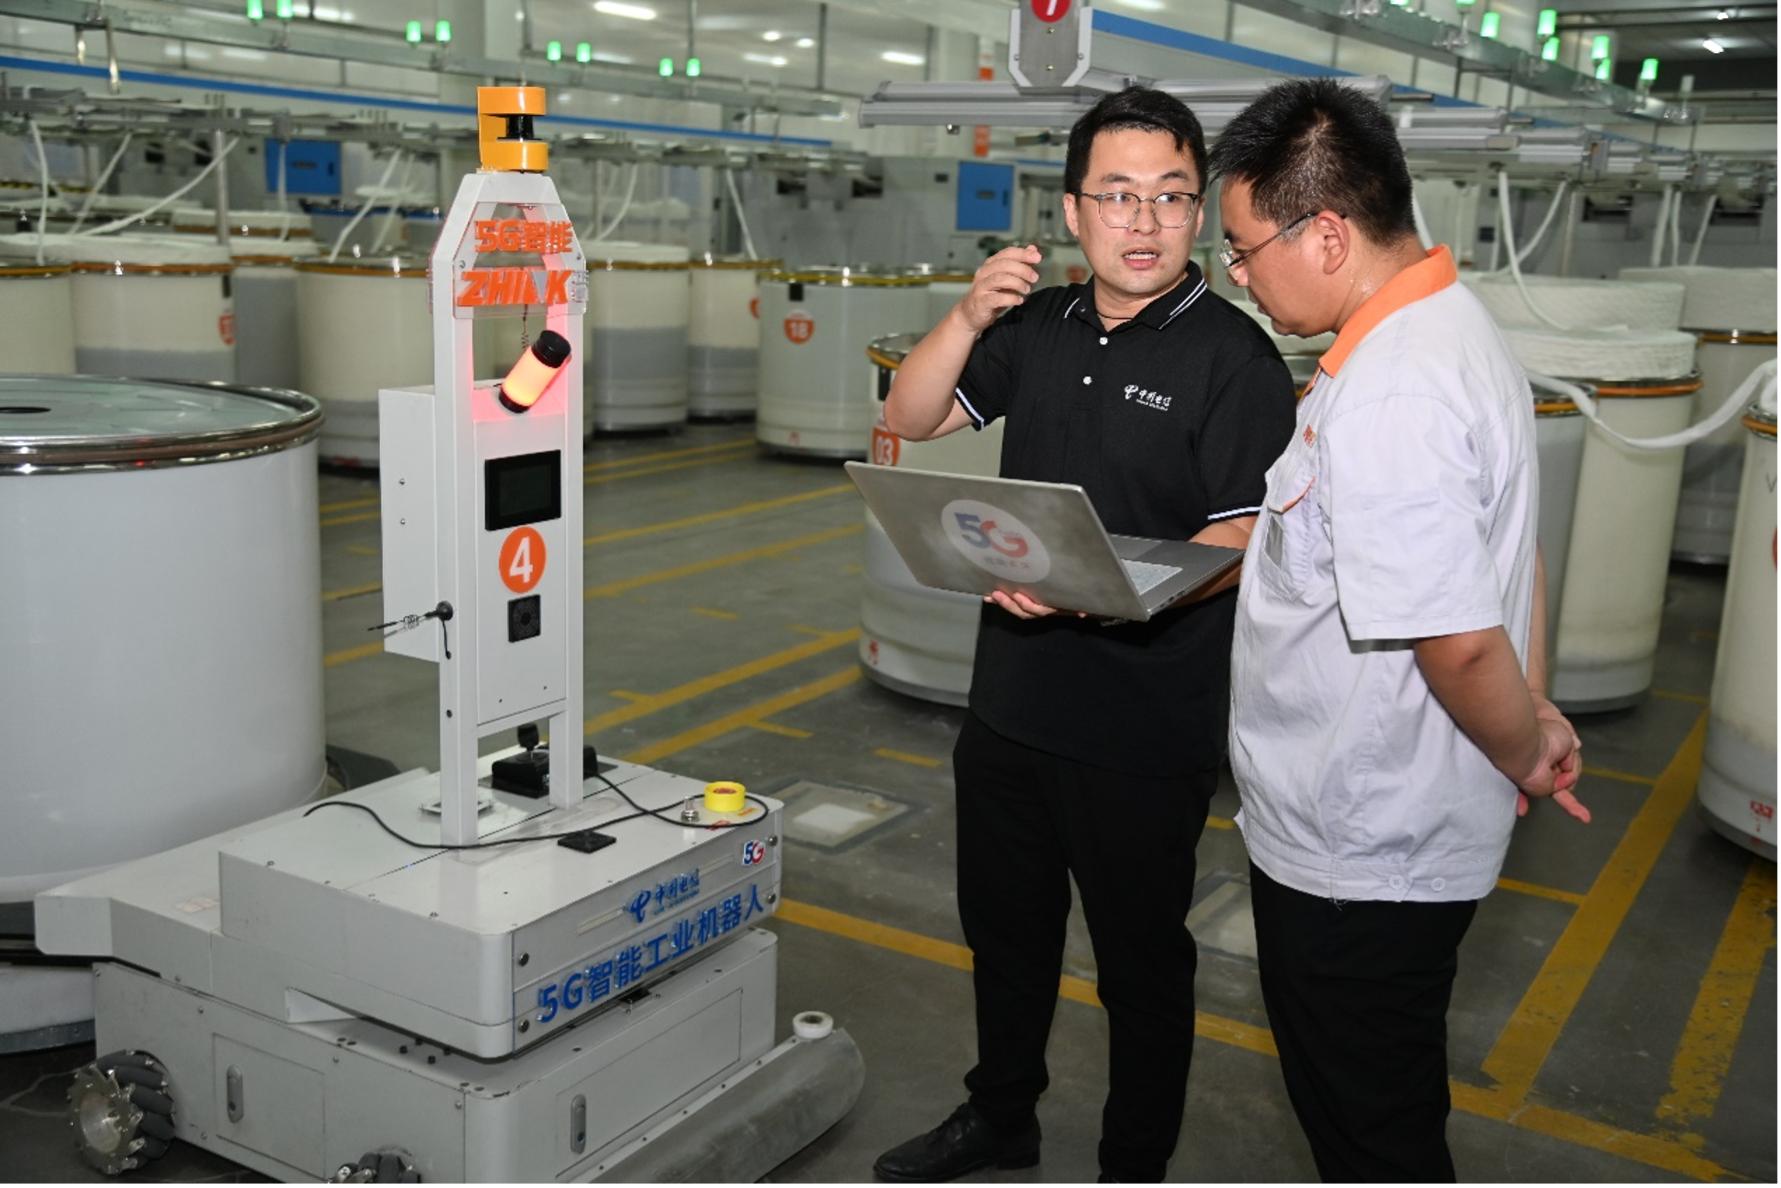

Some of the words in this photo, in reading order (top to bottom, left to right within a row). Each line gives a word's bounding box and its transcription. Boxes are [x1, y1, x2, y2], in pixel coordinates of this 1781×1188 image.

[475, 221, 573, 254] 5G智能
[876, 436, 894, 465] 03
[954, 512, 1028, 558] 5G
[509, 535, 534, 583] 4
[742, 840, 766, 865] 5G
[537, 884, 764, 1024] 5G智能工业机器人
